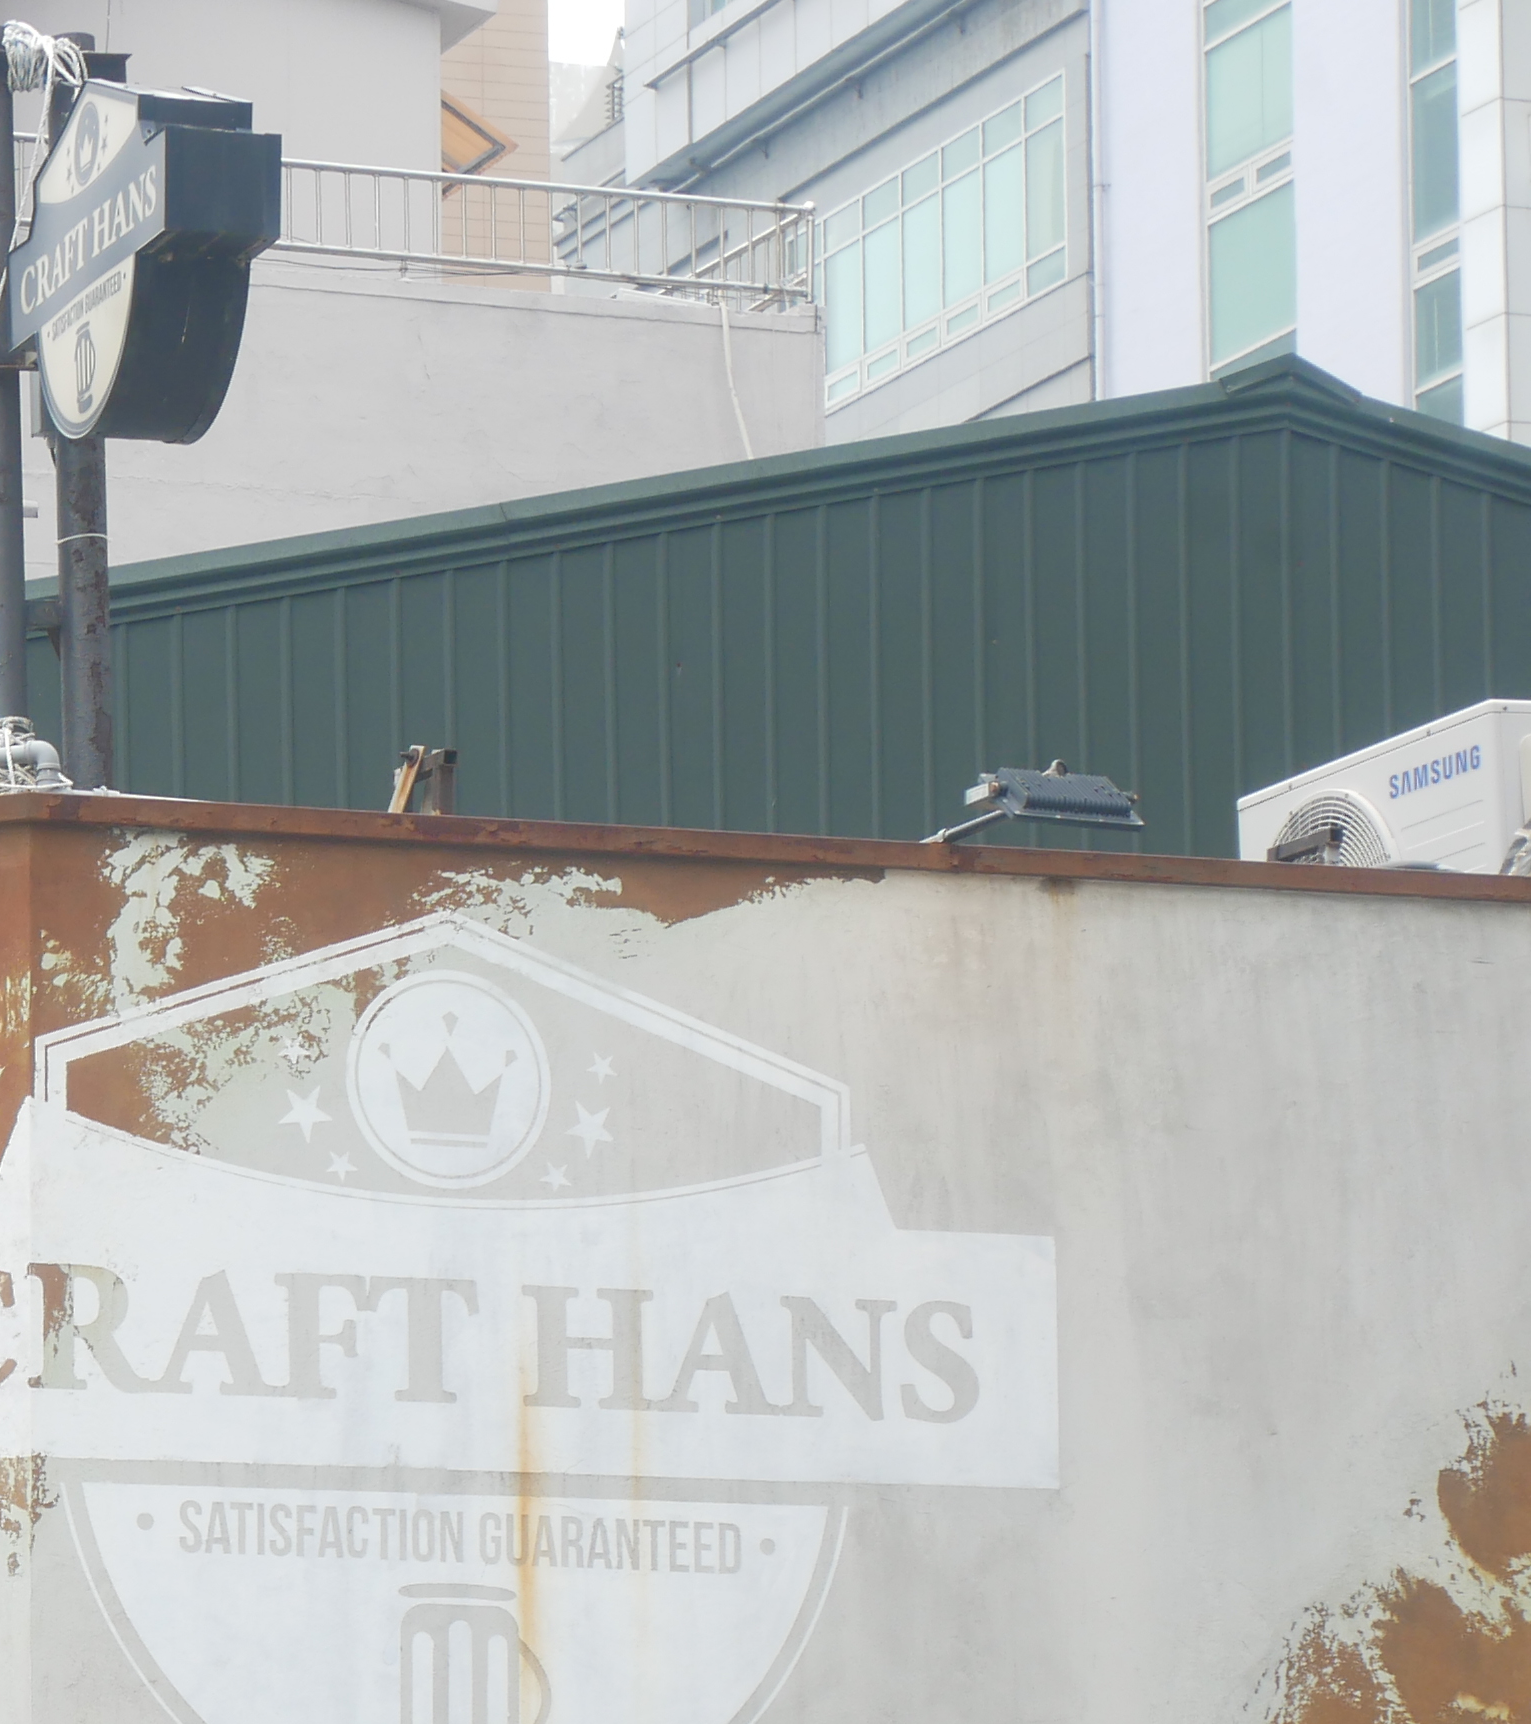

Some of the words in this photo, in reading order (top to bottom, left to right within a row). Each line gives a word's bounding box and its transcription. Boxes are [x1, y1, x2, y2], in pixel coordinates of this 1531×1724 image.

[20, 217, 88, 315] CRAFT
[92, 165, 156, 258] HANS
[51, 296, 84, 341] SATISFACTION
[85, 270, 122, 313] GUARANTEED
[1389, 744, 1482, 799] SAMSUNG
[520, 1284, 982, 1425] HANS
[178, 1498, 466, 1565] SATISFACTION
[478, 1505, 744, 1577] GUARANTEED
